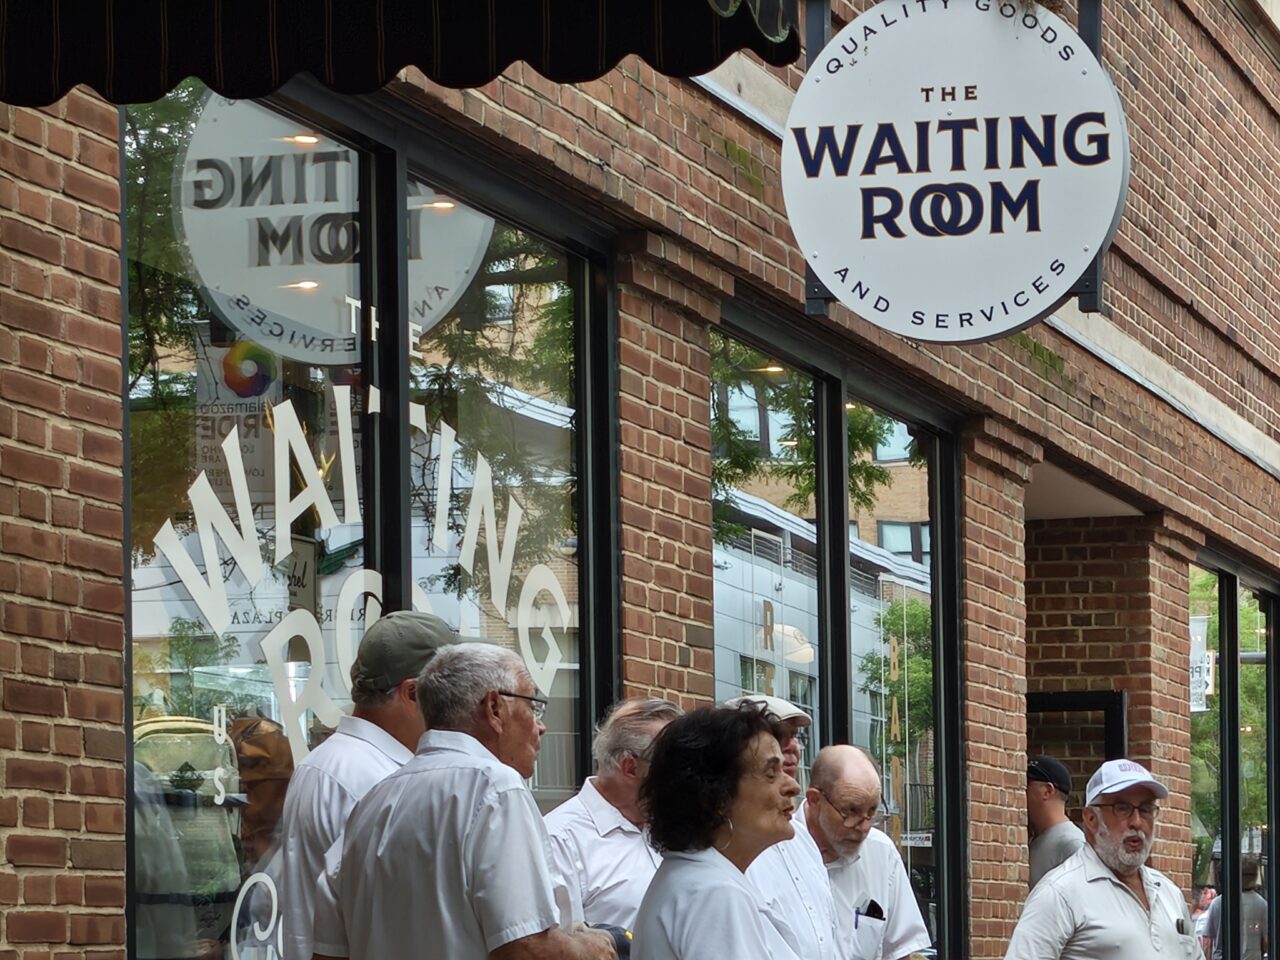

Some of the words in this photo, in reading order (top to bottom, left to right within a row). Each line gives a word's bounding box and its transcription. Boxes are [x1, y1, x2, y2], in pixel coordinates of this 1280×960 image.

[826, 0, 951, 75] QUALITY
[974, 0, 1075, 62] GOODS
[921, 85, 978, 103] THE
[790, 111, 1112, 179] WAITING
[860, 179, 1042, 241] ROOM
[834, 266, 890, 313] AND
[911, 258, 1066, 329] SERVICES
